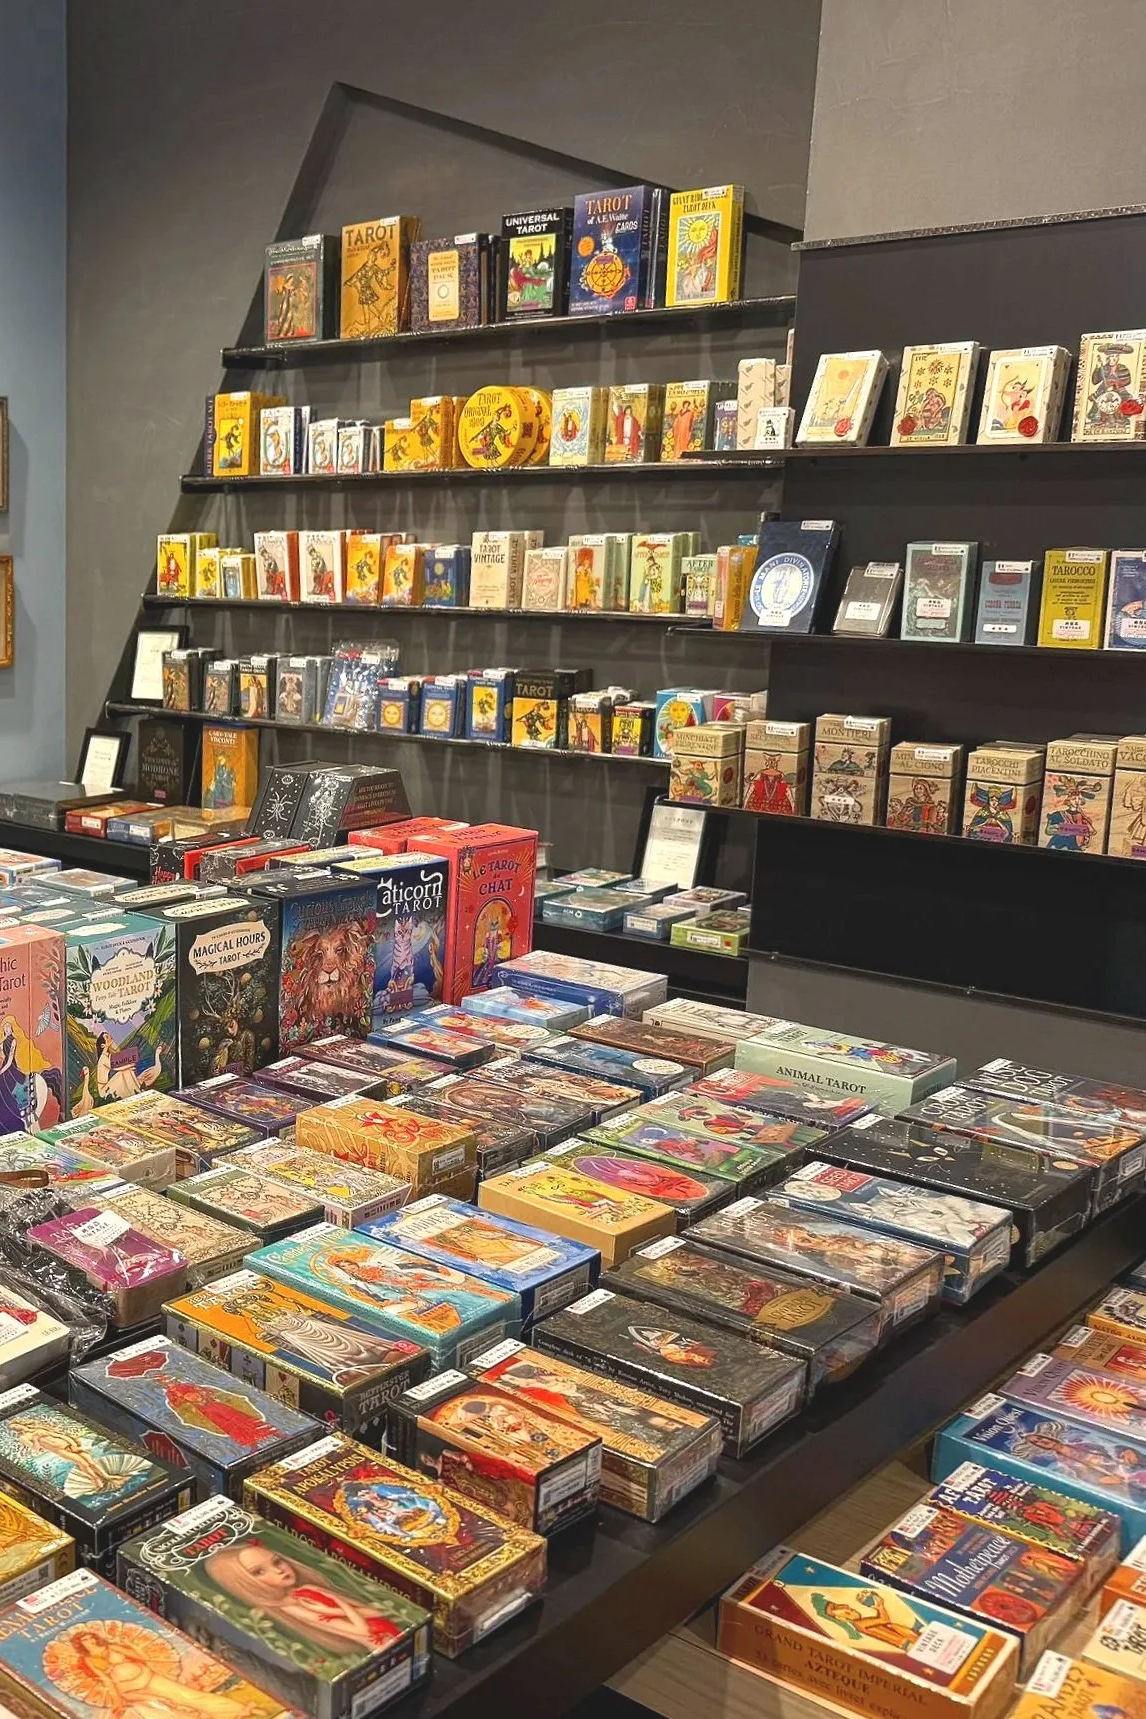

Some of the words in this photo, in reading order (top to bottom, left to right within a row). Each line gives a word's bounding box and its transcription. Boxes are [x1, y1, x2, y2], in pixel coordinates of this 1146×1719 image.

[586, 195, 632, 215] TAROT
[506, 212, 560, 227] UNIVERSAL
[516, 224, 548, 234] TAROT
[587, 216, 594, 224] of
[345, 224, 396, 247] TAROT
[477, 392, 502, 404] TAROT
[474, 553, 505, 563] VINTAGE
[479, 543, 500, 554] TAROT
[1052, 565, 1095, 576] TAROCCO
[516, 684, 554, 697] TAROT
[975, 758, 1018, 768] TAROCCHI
[1051, 747, 1109, 760] TAROCCHINO
[1064, 757, 1109, 768] SOLDATO
[972, 766, 1021, 777] PIACENTINI
[472, 864, 486, 880] LE
[488, 859, 521, 873] TAROT
[479, 878, 513, 895] CHAT
[393, 895, 442, 913] TAROT
[194, 941, 234, 959] MAGICAL
[236, 931, 266, 948] HOURS
[219, 952, 241, 965] TAROT
[92, 970, 154, 993] WOODLAND
[118, 982, 151, 999] TAROT
[111, 1054, 137, 1068] SAMPLE
[775, 1066, 823, 1087] ANIMAL
[825, 1077, 867, 1095] TAROT
[1004, 1066, 1052, 1092] DOG
[1032, 1075, 1074, 1097] TAROT
[947, 1097, 995, 1121] TAROT
[780, 1301, 821, 1322] TAROT
[359, 1379, 411, 1415] TAROT
[973, 1419, 1000, 1442] Vision
[999, 1408, 1024, 1434] Quest
[294, 1456, 366, 1494] APOKALYPSIS
[299, 1457, 332, 1476] TAROT
[963, 1478, 998, 1505] TAROT
[926, 1535, 1012, 1598] Motherpeace
[18, 1601, 84, 1638] TAROT
[918, 1629, 937, 1653] VINTAGE
[931, 1639, 944, 1652] DECK
[754, 1624, 802, 1653] GRAND
[809, 1647, 852, 1670] TAROT
[859, 1666, 926, 1706] IMPERIAL
[804, 1659, 870, 1695] AZTEQUE
[807, 1674, 829, 1692] avec
